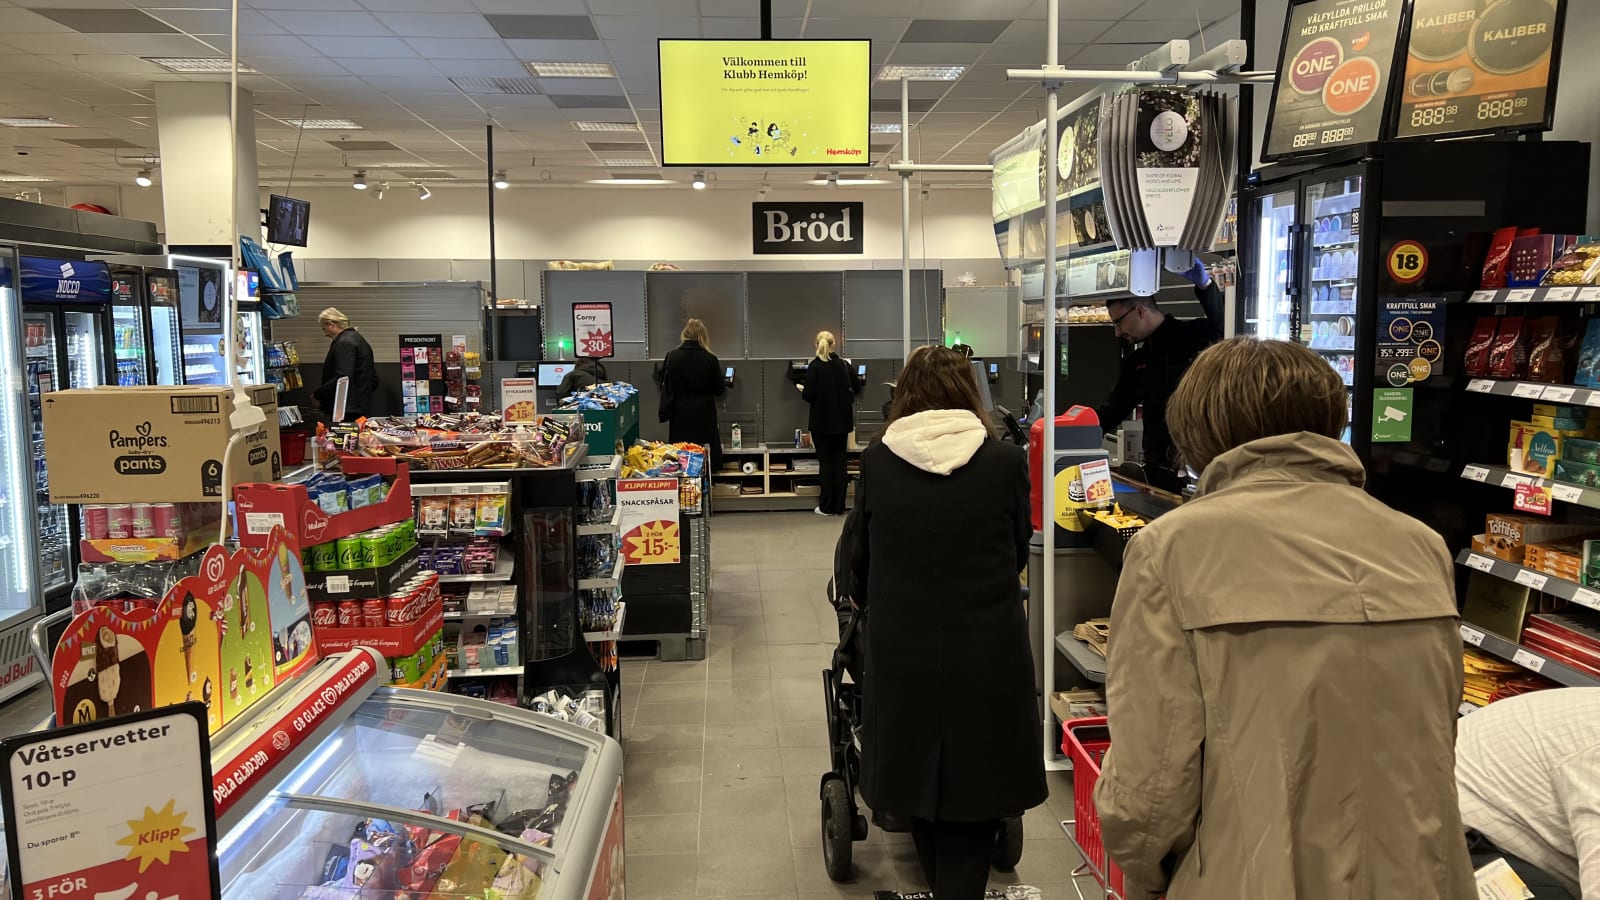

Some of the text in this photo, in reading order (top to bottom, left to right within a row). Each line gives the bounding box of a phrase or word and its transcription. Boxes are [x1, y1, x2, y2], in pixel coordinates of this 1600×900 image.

[1307, 0, 1386, 24] VÄLFYLLDA PRILLOR
[1416, 10, 1476, 29] KALIBER
[1301, 10, 1388, 36] MED KRAFTFULL SMAK
[1483, 22, 1547, 42] KALIBER
[722, 56, 806, 66] Välkommen till
[1296, 54, 1336, 75] ONE
[724, 70, 808, 80] Klubb Hemköp!
[1330, 74, 1372, 95] ONE
[1164, 118, 1173, 144] VELO
[826, 148, 862, 156] Hemköp
[764, 208, 854, 242] Bröd
[1396, 254, 1419, 270] 18
[56, 280, 80, 293] NOCCO
[588, 340, 610, 352] 30:-
[110, 430, 167, 450] Pampers
[120, 457, 162, 472] pants
[250, 449, 266, 464] pants
[208, 464, 218, 476] 6
[621, 498, 674, 506] SNACKSPÅSAR
[1516, 493, 1524, 507] 8
[1488, 520, 1520, 541] Toffifee
[642, 538, 673, 556] 15:-
[13, 656, 34, 680] Bull
[293, 699, 326, 731] GB GLACE
[18, 724, 170, 766] Våtservetter
[21, 769, 76, 790] 10-p
[41, 835, 68, 846] sparar
[138, 827, 180, 846] Klipp
[33, 889, 44, 900] 3
[48, 878, 88, 898] FÖR
